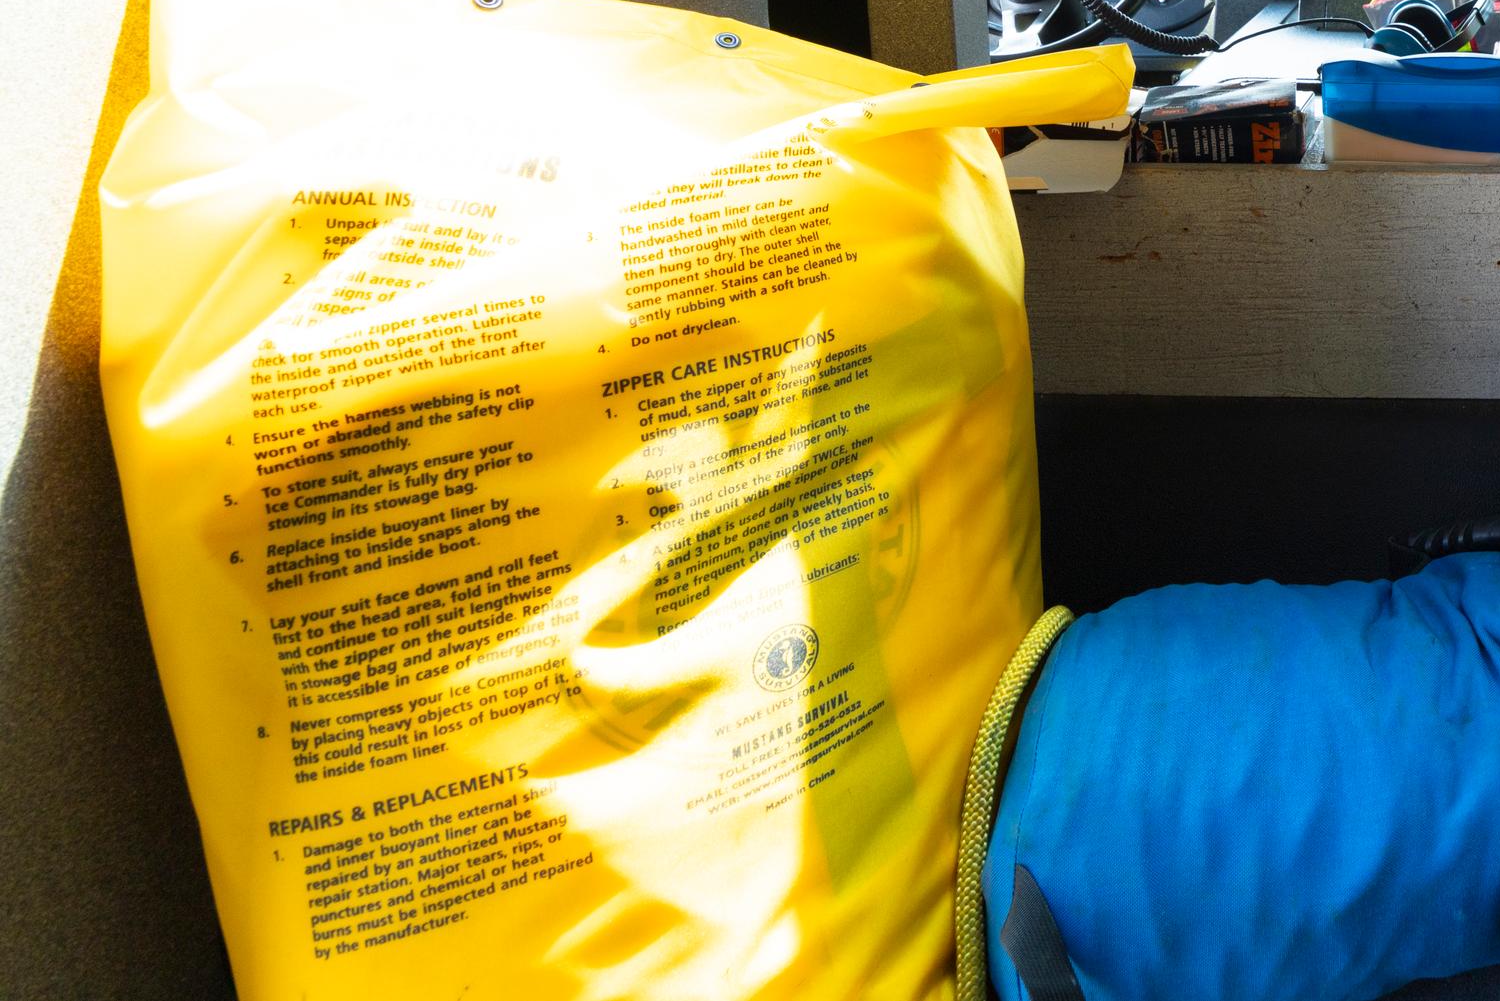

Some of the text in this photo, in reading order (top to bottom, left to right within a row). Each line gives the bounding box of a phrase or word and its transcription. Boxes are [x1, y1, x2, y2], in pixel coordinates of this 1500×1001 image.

[292, 190, 377, 206] ANNUAL
[627, 249, 858, 310] same manner. Stains can be cleaned by
[631, 316, 740, 346] Do not dryclean.
[600, 331, 836, 397] ZIPPER CARE INSTRUCTIONS
[225, 381, 521, 447] 4. Ensure the harness webbing is not
[254, 397, 535, 459] worn or abraded and the safety clip
[224, 442, 514, 506] 5. To store suit, always ensure your
[257, 435, 411, 475] functions smoothly.
[265, 451, 534, 514] Ice Commander is fully dry prior to
[229, 497, 510, 564] 6. Replace inside buoyant liner by
[267, 483, 478, 530] stowing in its stowage bag.
[653, 489, 890, 587] as a minimum, paying close attention to
[265, 505, 541, 574] attaching to inside snaps along the
[266, 534, 481, 592] shell front and inside boot.
[732, 690, 849, 759] MUSTANG SURVIVAL
[735, 713, 763, 728] SAVE
[767, 697, 794, 715] LIVES
[817, 680, 825, 690] A
[826, 662, 855, 685] LIVING
[269, 767, 530, 838] REPAIRS & REPLACEMENTS
[718, 764, 749, 781] TOLL
[766, 768, 836, 812] Made in China
[308, 832, 563, 908] repair station. Major tears, rips, or
[310, 849, 545, 929] punctures and chemical or heat
[312, 852, 595, 943] burns must be inspected and repaired
[314, 914, 469, 960] by the manufacturer.
